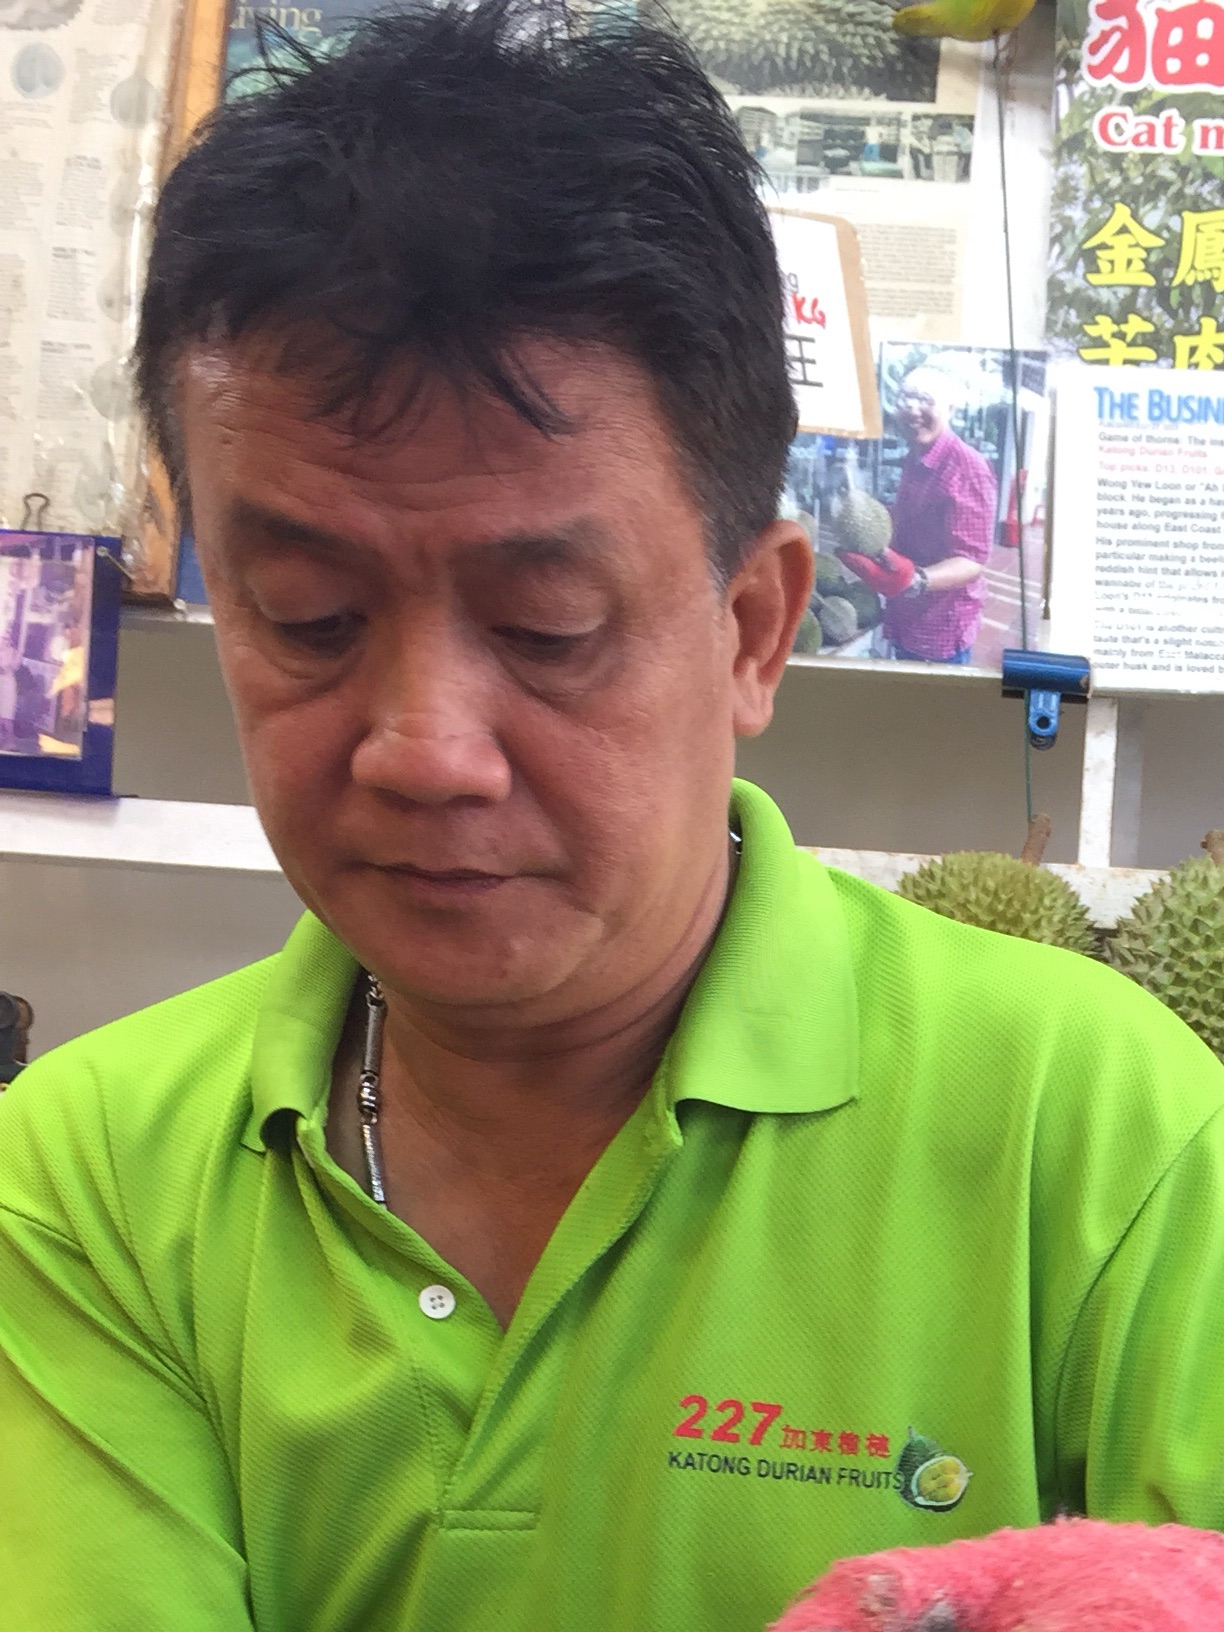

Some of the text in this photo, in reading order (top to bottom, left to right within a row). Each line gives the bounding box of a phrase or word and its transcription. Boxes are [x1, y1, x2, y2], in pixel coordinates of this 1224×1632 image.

[229, 0, 323, 42] iving
[1098, 112, 1178, 148] Cat
[792, 293, 826, 329] KG
[1093, 386, 1138, 421] THE
[673, 1394, 783, 1446] 227
[668, 1451, 906, 1492] KATONG DURIAN FRUITS
